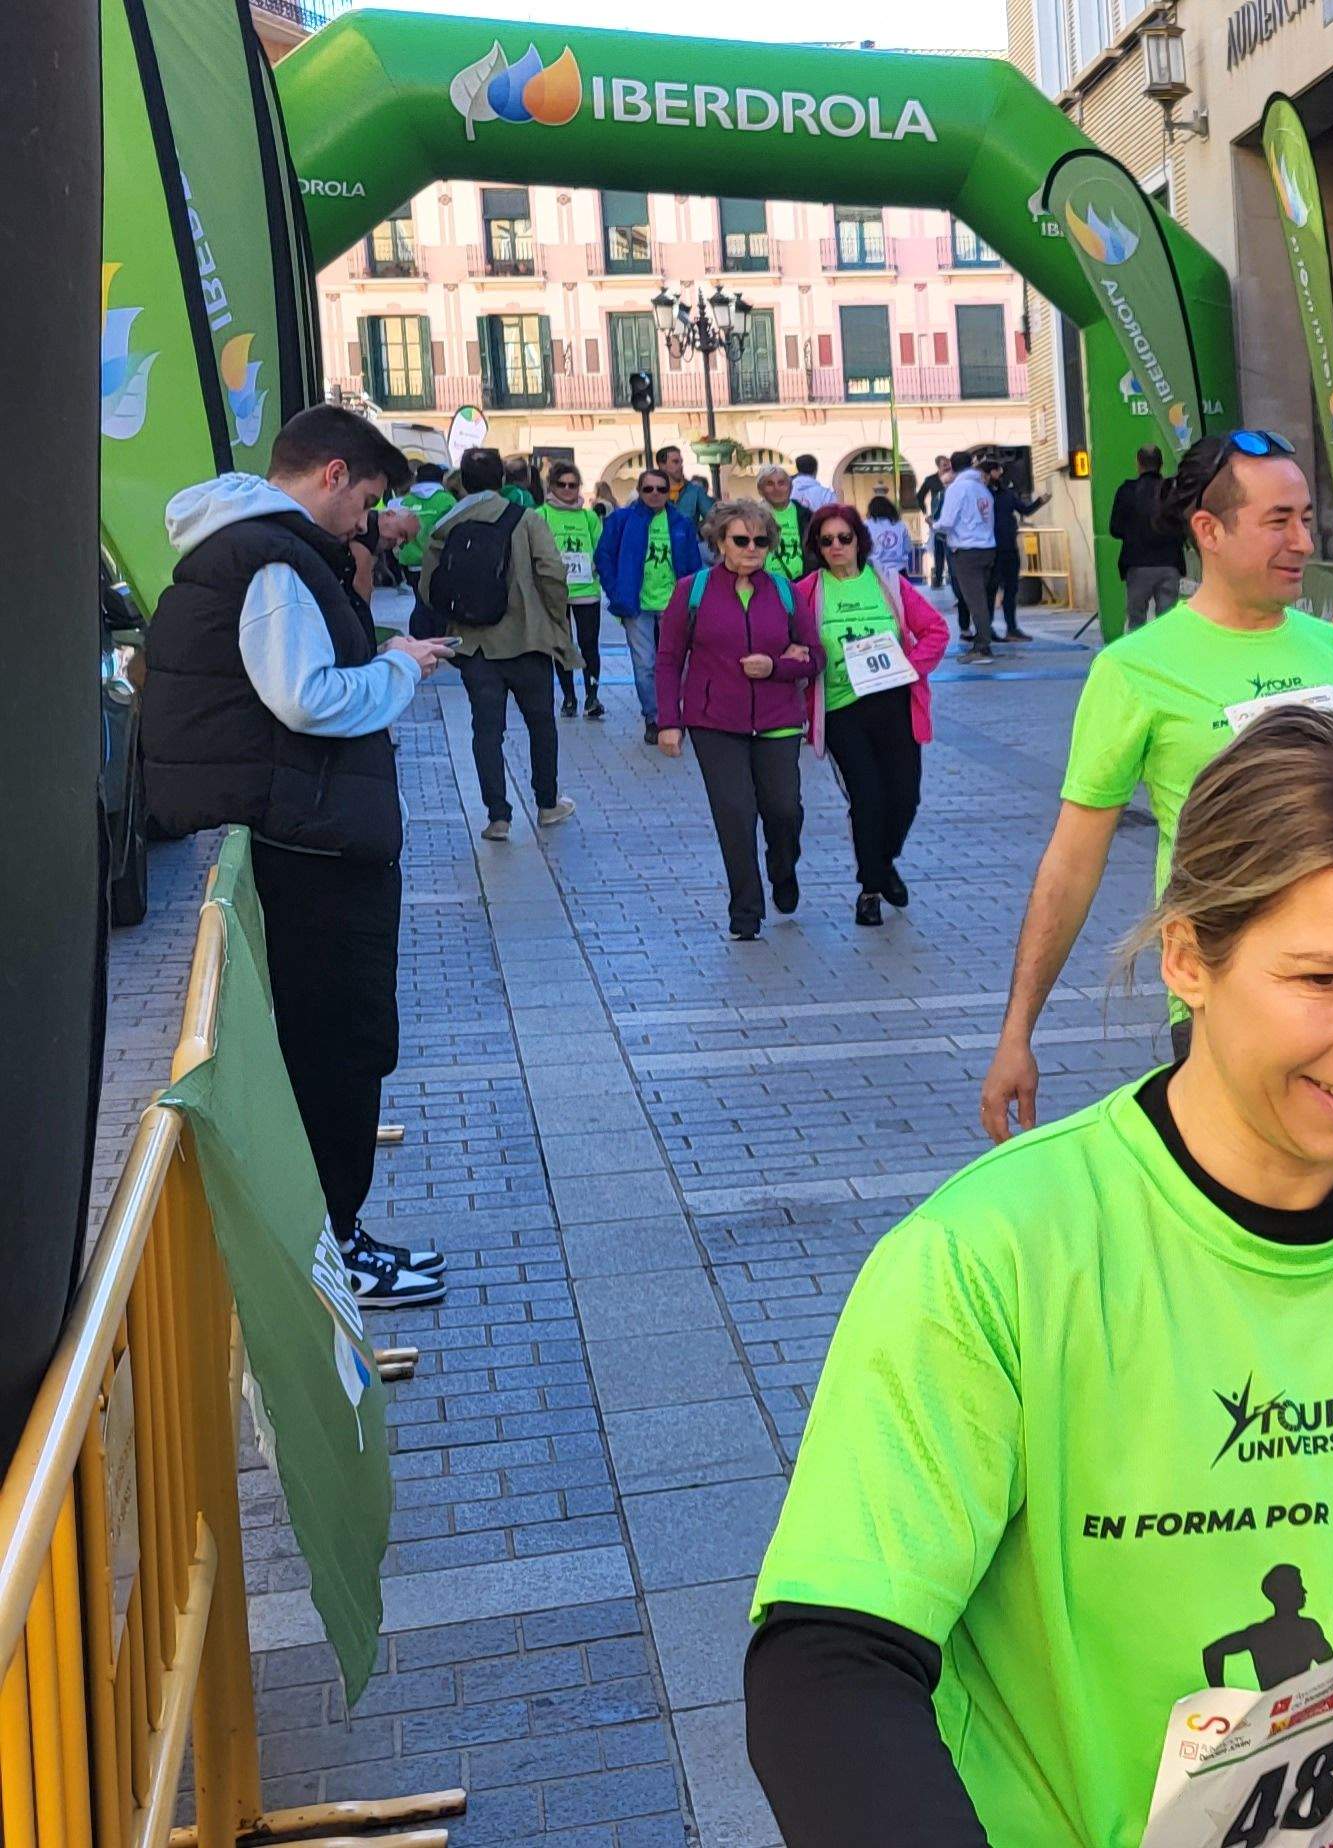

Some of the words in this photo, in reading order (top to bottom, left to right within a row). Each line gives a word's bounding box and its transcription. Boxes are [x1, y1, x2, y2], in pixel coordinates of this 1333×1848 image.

[592, 76, 938, 143] IBERDROLA
[298, 178, 366, 197] DROLA
[866, 653, 891, 673] 90
[1265, 677, 1303, 691] TOUR
[1082, 1513, 1126, 1540] EN
[1134, 1506, 1257, 1539] FORMA
[1265, 1502, 1329, 1528] POR
